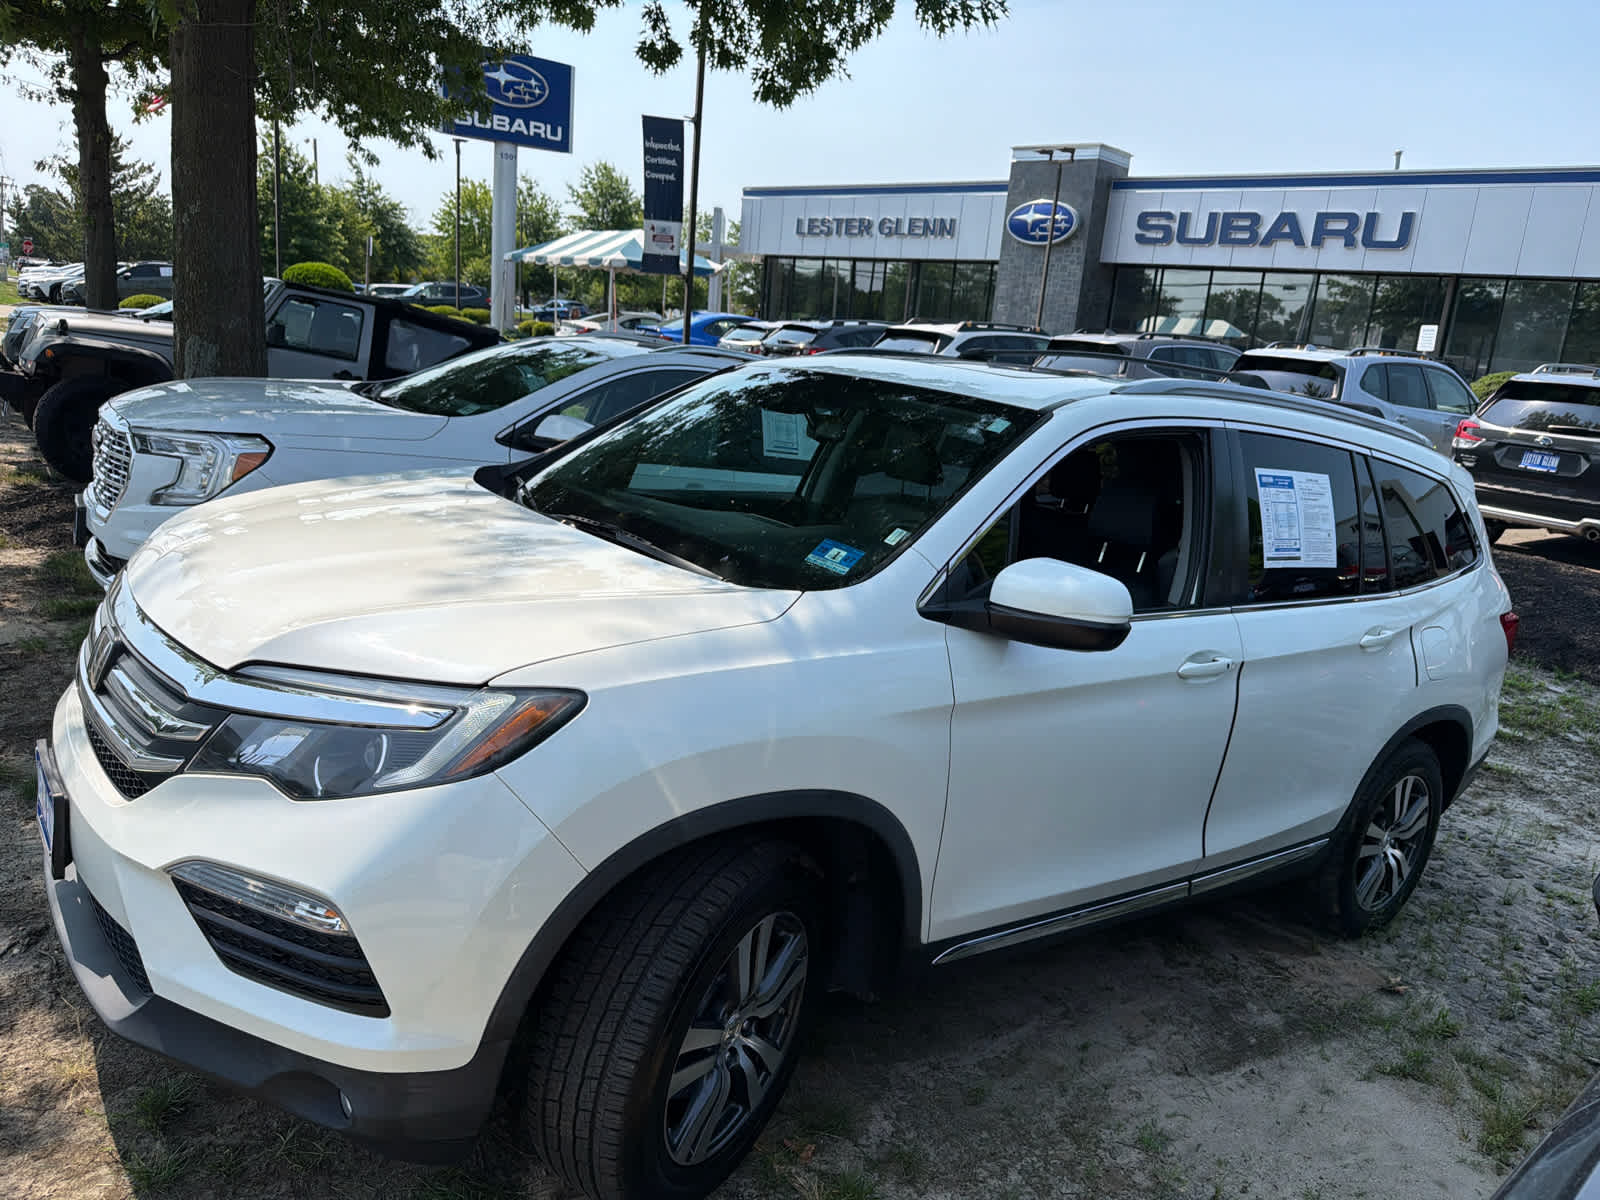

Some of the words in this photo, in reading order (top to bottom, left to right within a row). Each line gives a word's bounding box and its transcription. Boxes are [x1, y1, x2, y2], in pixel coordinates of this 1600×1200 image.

[795, 216, 874, 238] LESTER
[878, 216, 957, 239] GLENN
[1134, 210, 1416, 250] SUBARU
